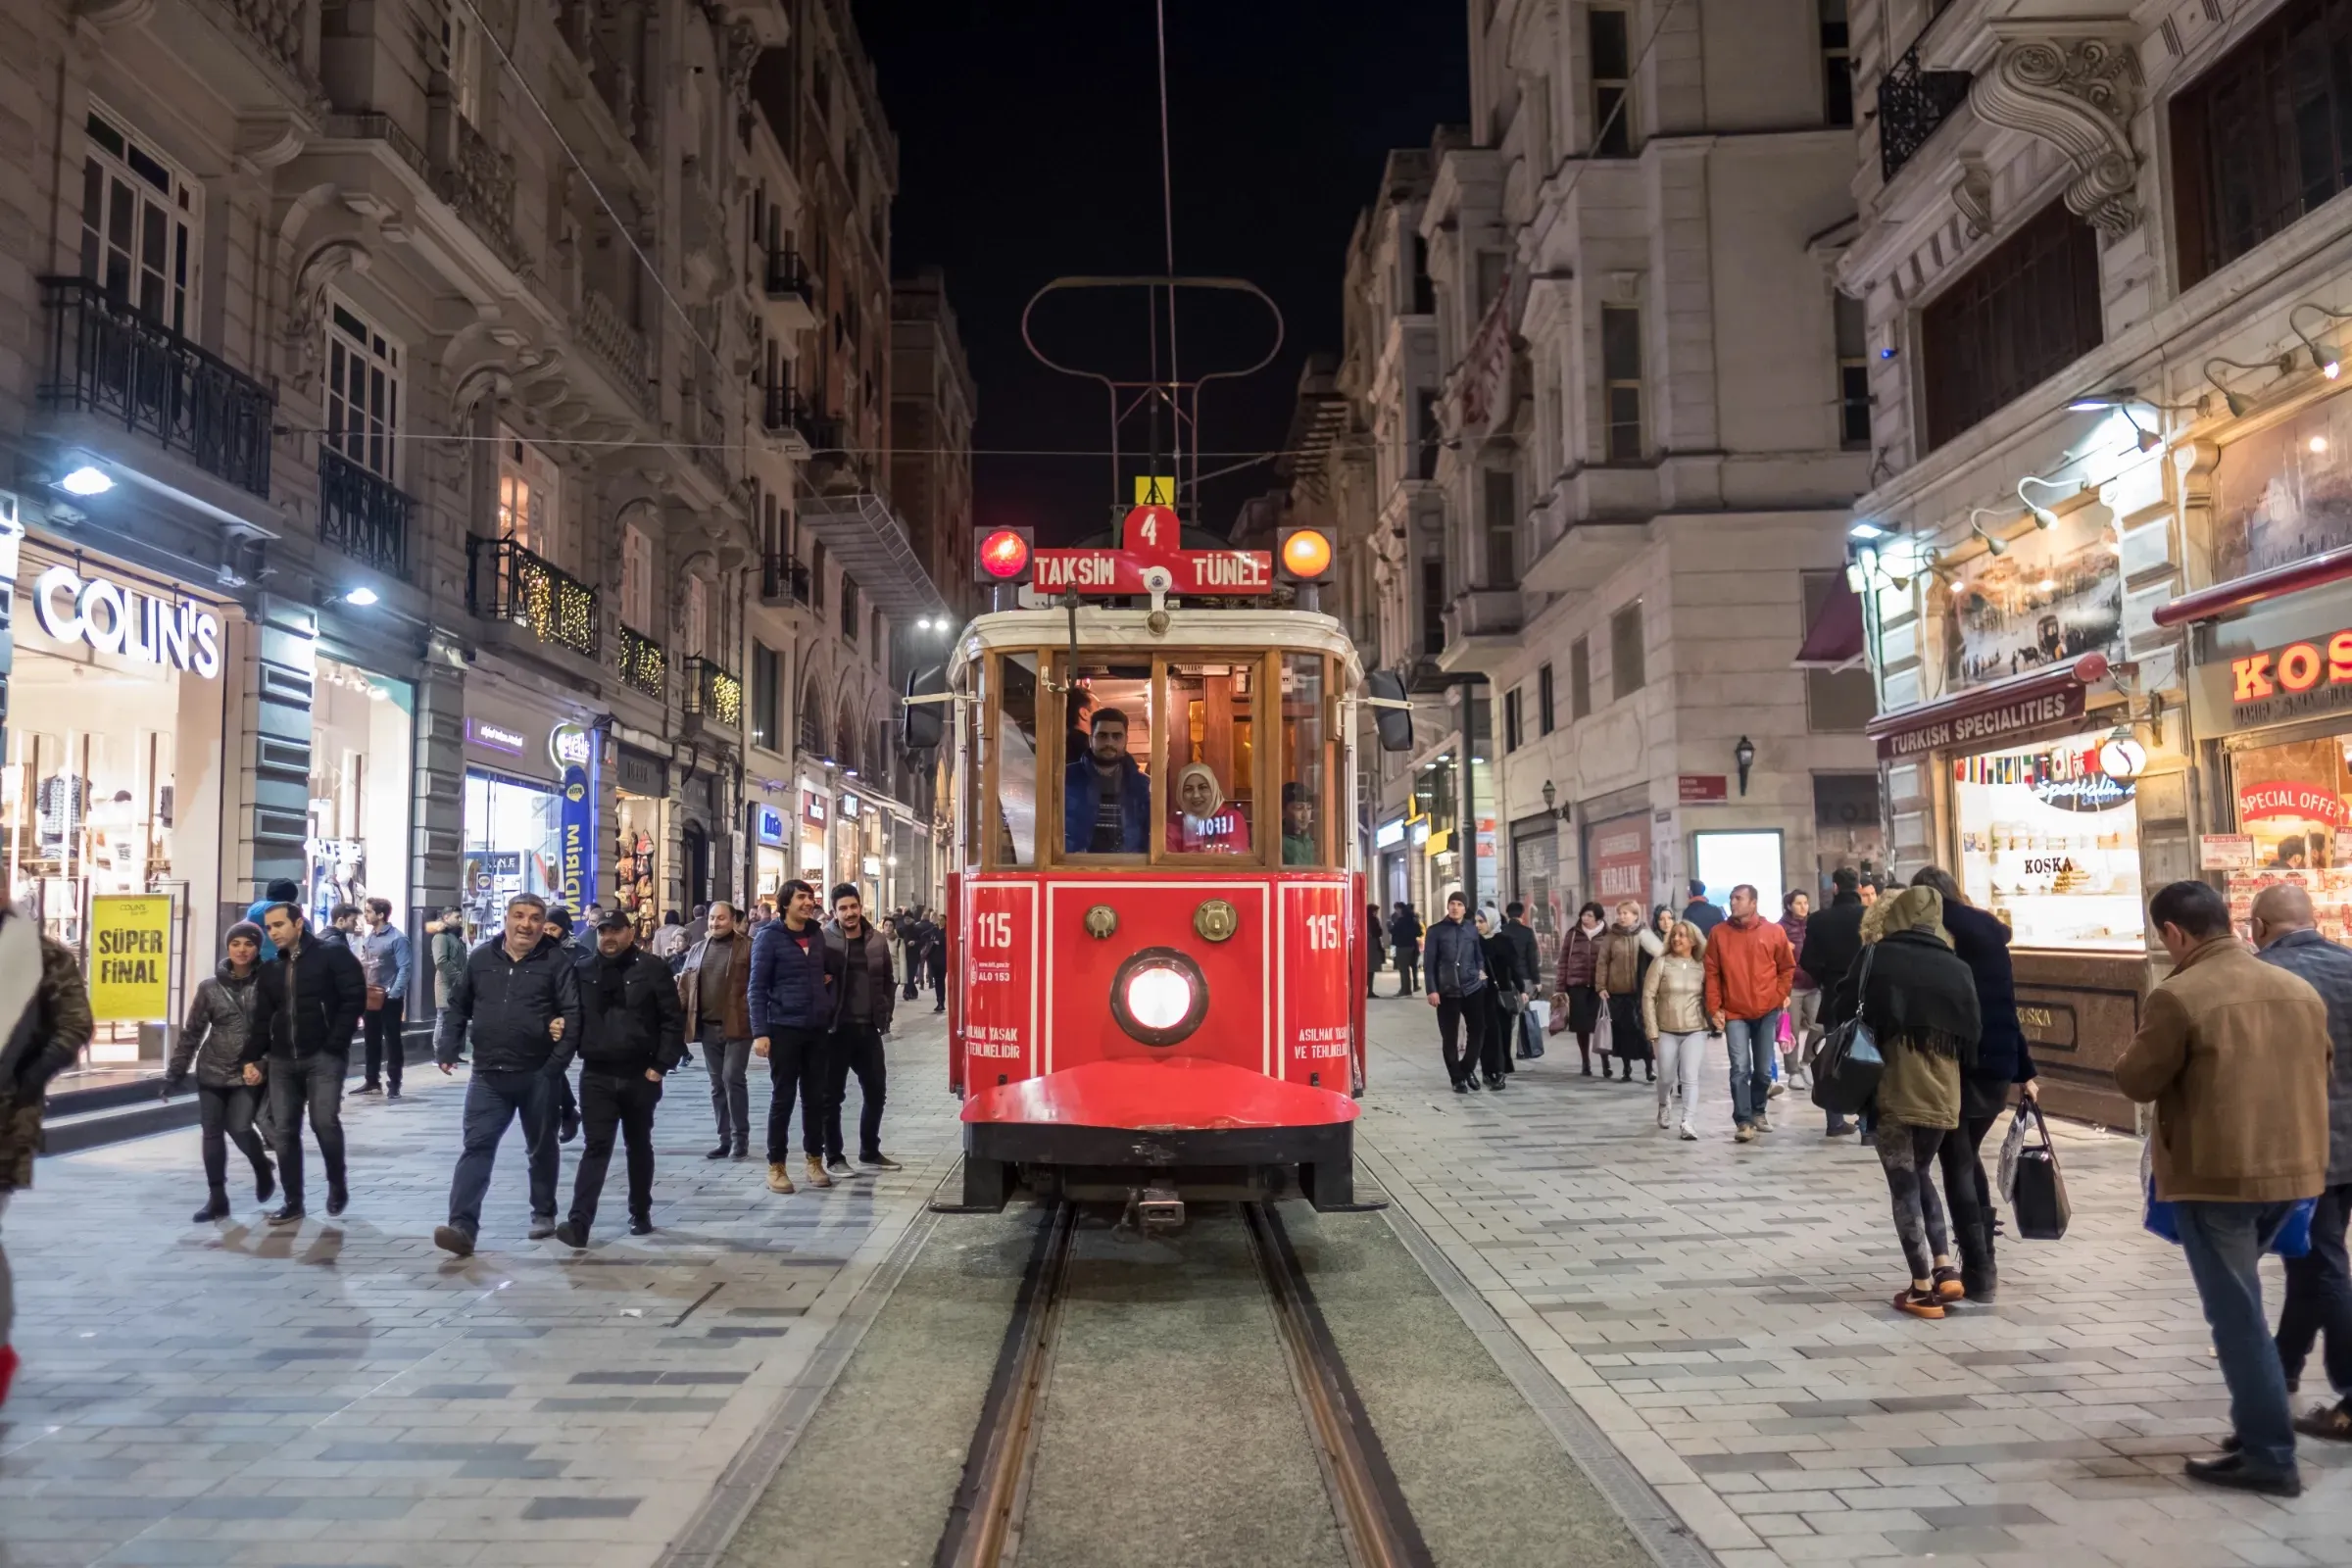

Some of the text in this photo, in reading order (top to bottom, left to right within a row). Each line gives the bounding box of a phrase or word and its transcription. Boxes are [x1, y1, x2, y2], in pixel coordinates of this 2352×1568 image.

[1141, 514, 1157, 546] 4
[1035, 552, 1267, 586] TAKSİM TÜNEL
[33, 564, 220, 679] COLIN'S
[1890, 693, 2066, 756] TURKISH SPECIALITIES
[2240, 790, 2295, 814] SPECIAL
[1601, 862, 1642, 895] KİRALIK
[99, 928, 164, 954] SÜPER
[978, 912, 1011, 948] 115
[1306, 914, 1337, 949] 115
[101, 957, 159, 984] FİNAL
[978, 971, 1010, 982] ALO 153
[990, 1026, 1018, 1041] YASAK
[1298, 1027, 1334, 1042] ASILMAK
[1295, 1045, 1307, 1059] VE
